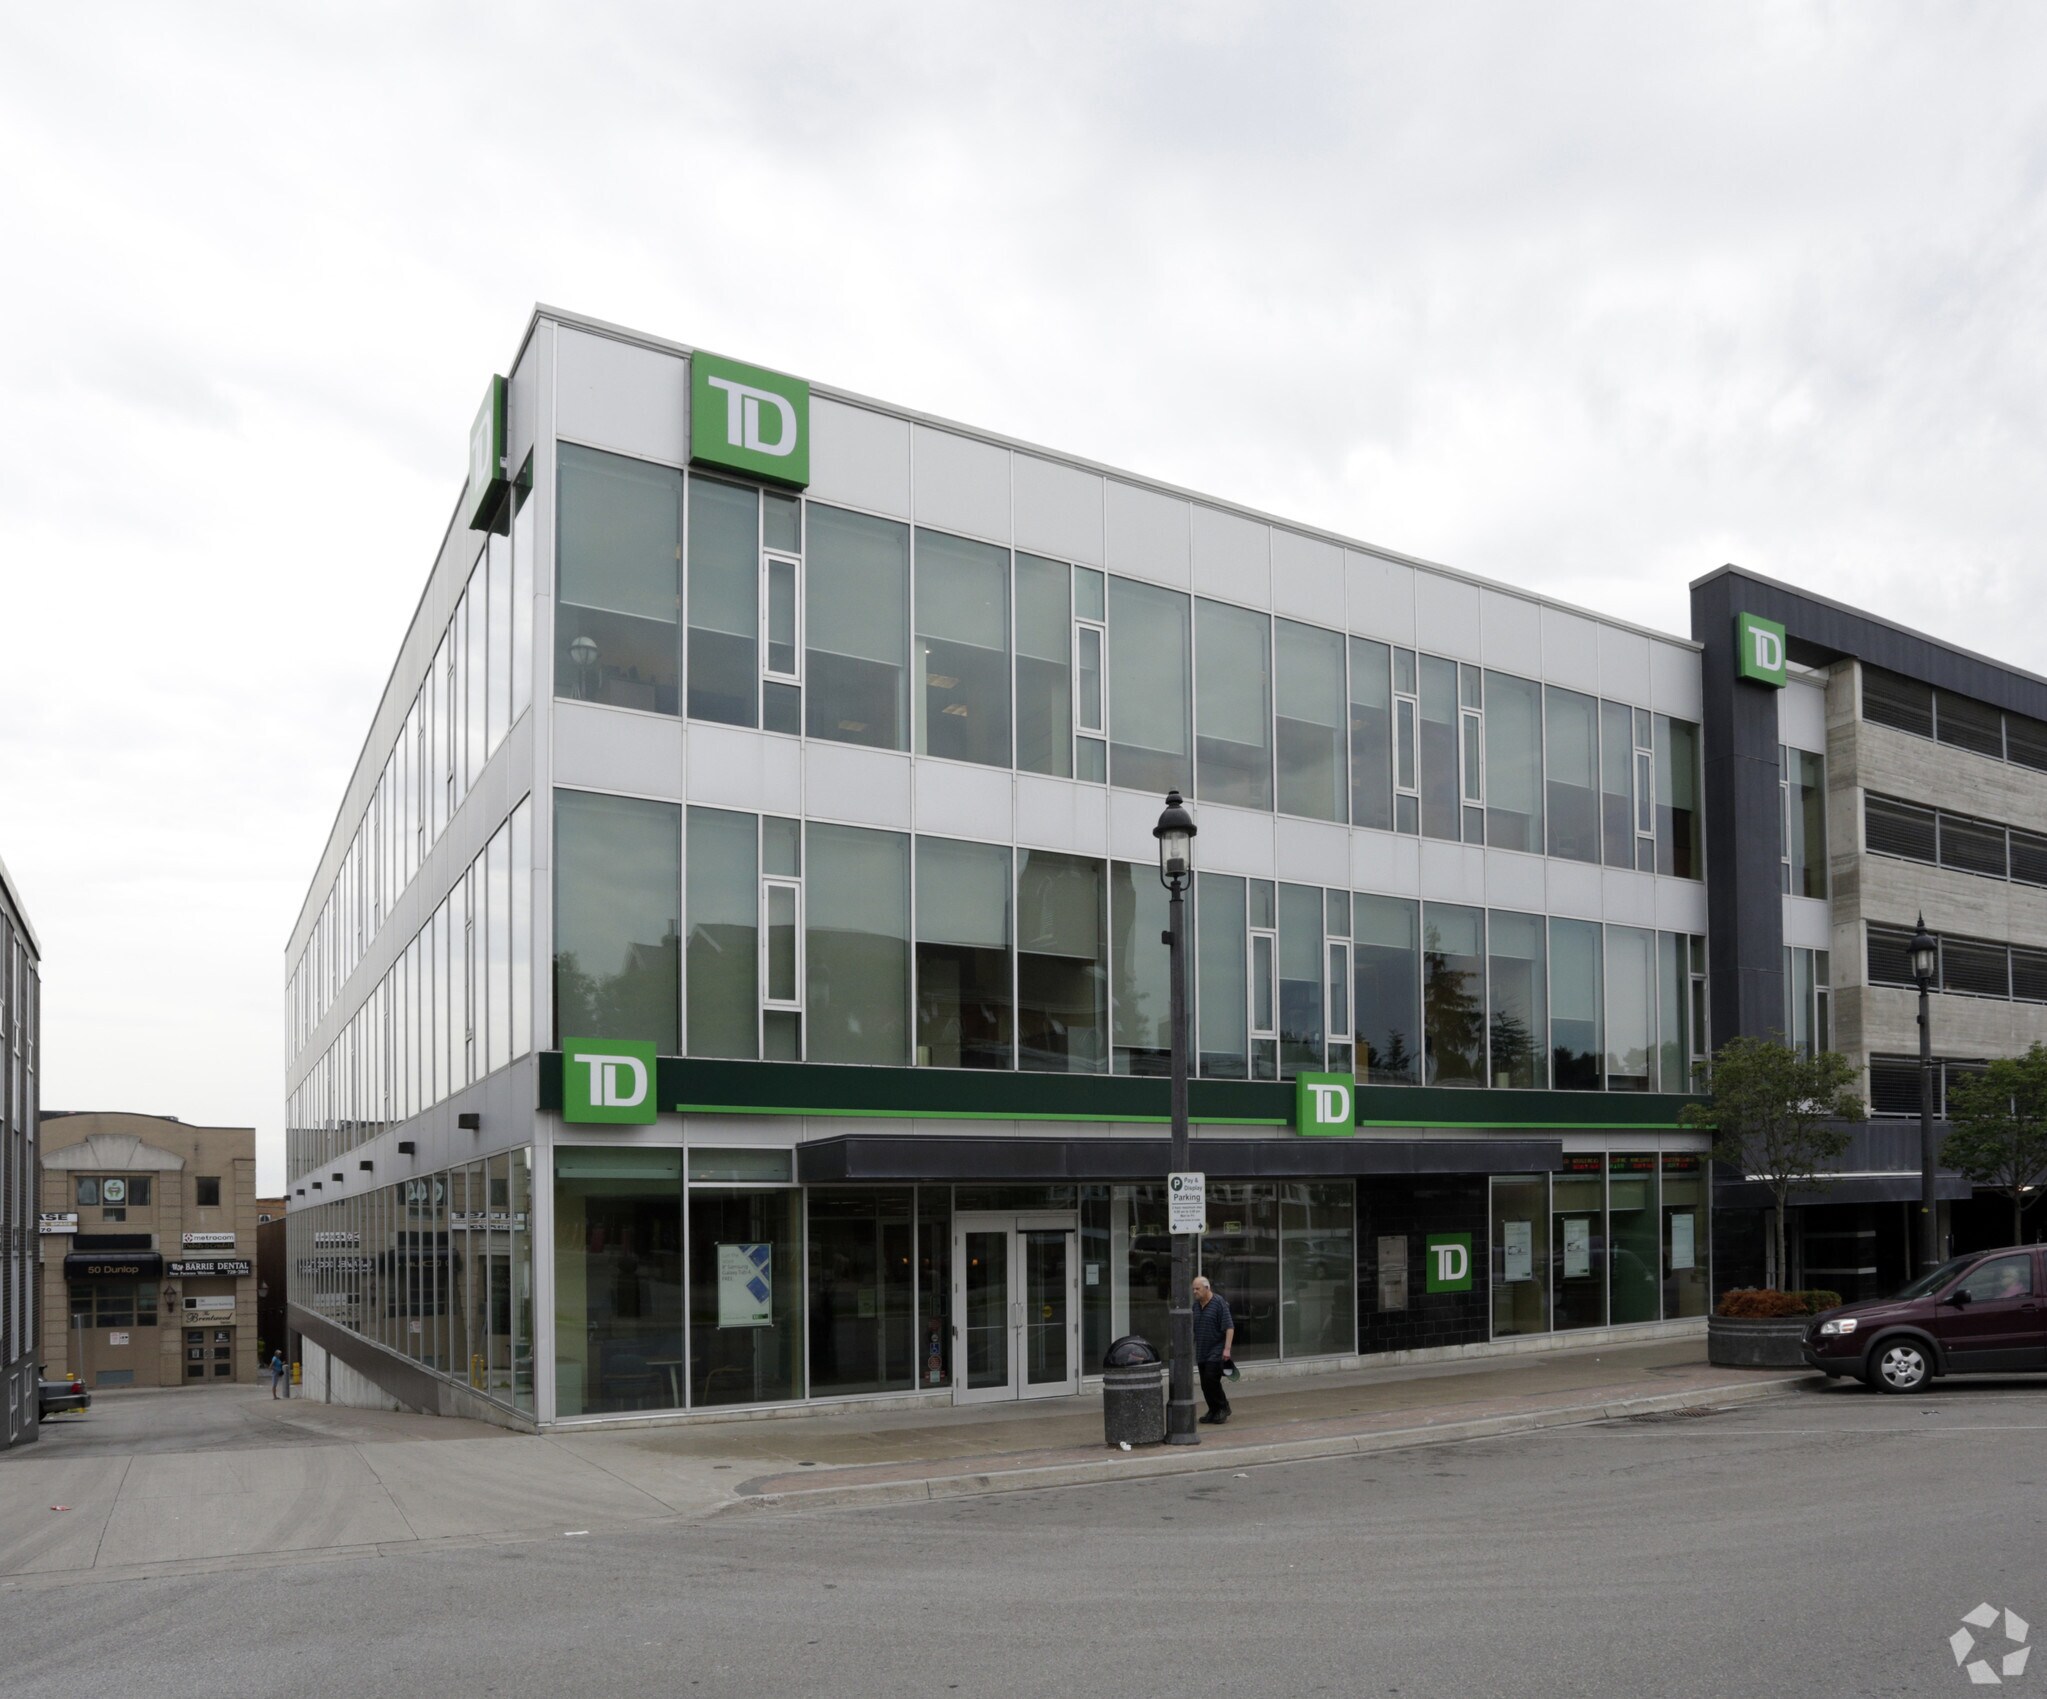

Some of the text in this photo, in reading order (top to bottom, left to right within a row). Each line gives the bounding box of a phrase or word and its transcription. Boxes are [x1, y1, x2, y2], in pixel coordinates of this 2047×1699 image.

[709, 376, 796, 457] TD
[472, 410, 490, 492] TD
[1748, 626, 1782, 672] TD
[574, 1054, 648, 1106] TD
[1307, 1083, 1349, 1123] TD
[1174, 1194, 1200, 1202] Parking
[88, 1266, 139, 1275] 50 Dunlop
[185, 1262, 214, 1270] BARRIE
[1430, 1244, 1468, 1280] TD
[186, 1312, 233, 1323] Brentwood
